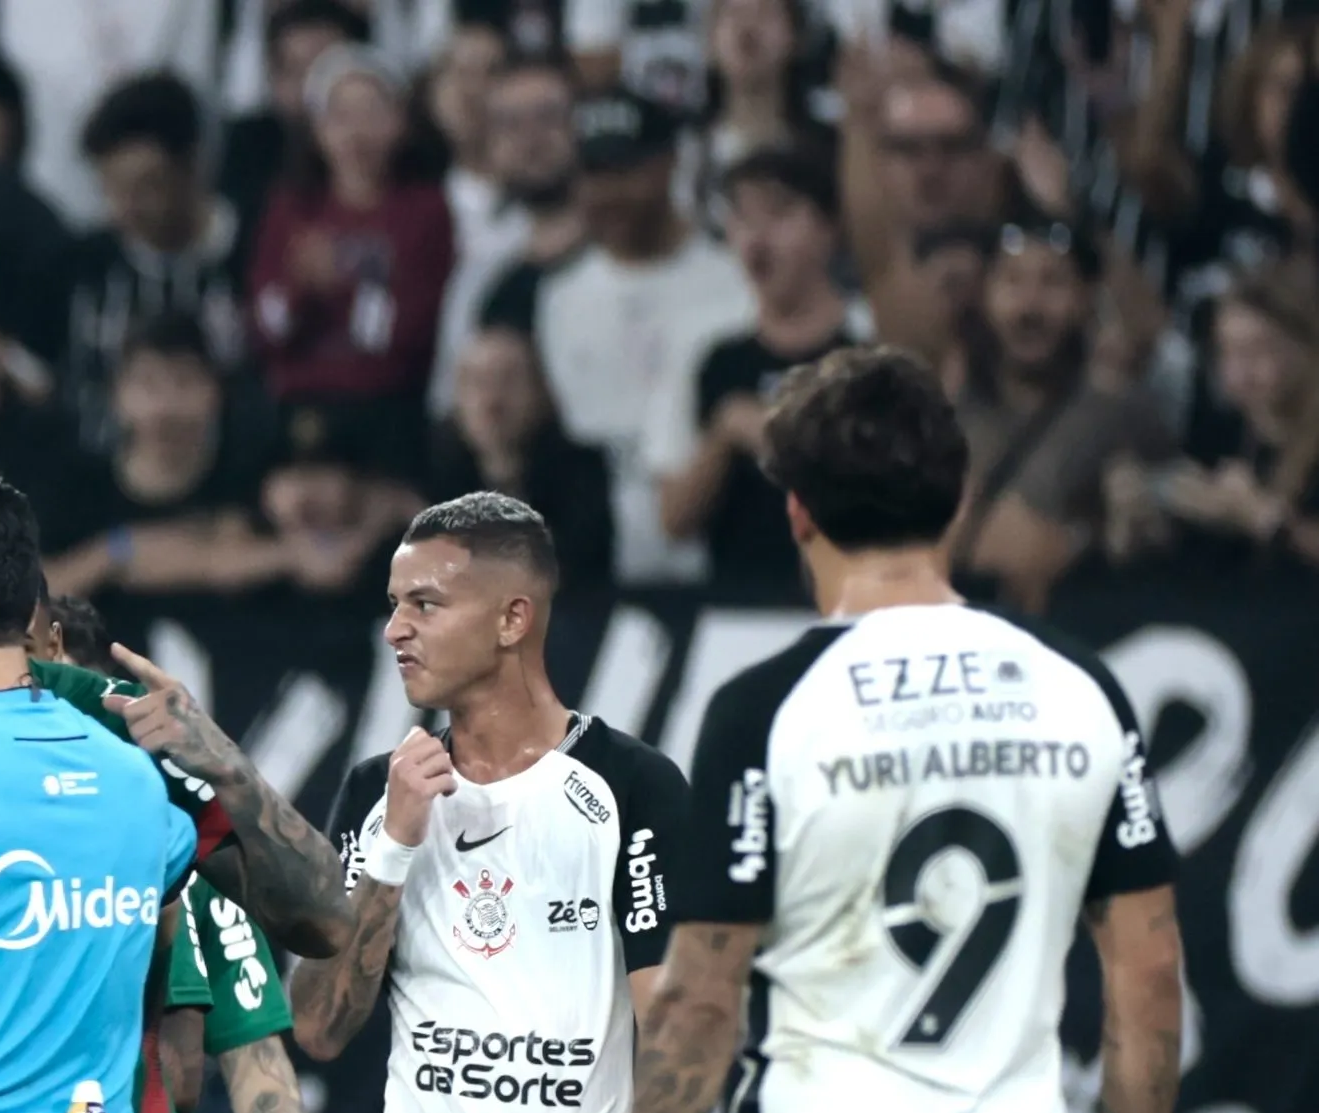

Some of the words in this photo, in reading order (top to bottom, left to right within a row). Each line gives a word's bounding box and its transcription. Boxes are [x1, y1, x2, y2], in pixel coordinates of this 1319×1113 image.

[848, 652, 987, 706] EZZE
[971, 701, 1039, 722] AUTO
[818, 749, 910, 796] YURI
[921, 740, 1090, 780] ALBERTO
[564, 770, 612, 825] Frimesa
[6, 874, 158, 942] Midea
[548, 900, 578, 924] Zé
[625, 853, 658, 933] bmg
[883, 801, 1024, 1052] 9
[411, 1020, 596, 1066] Esportes
[459, 1063, 584, 1107] Sorte
